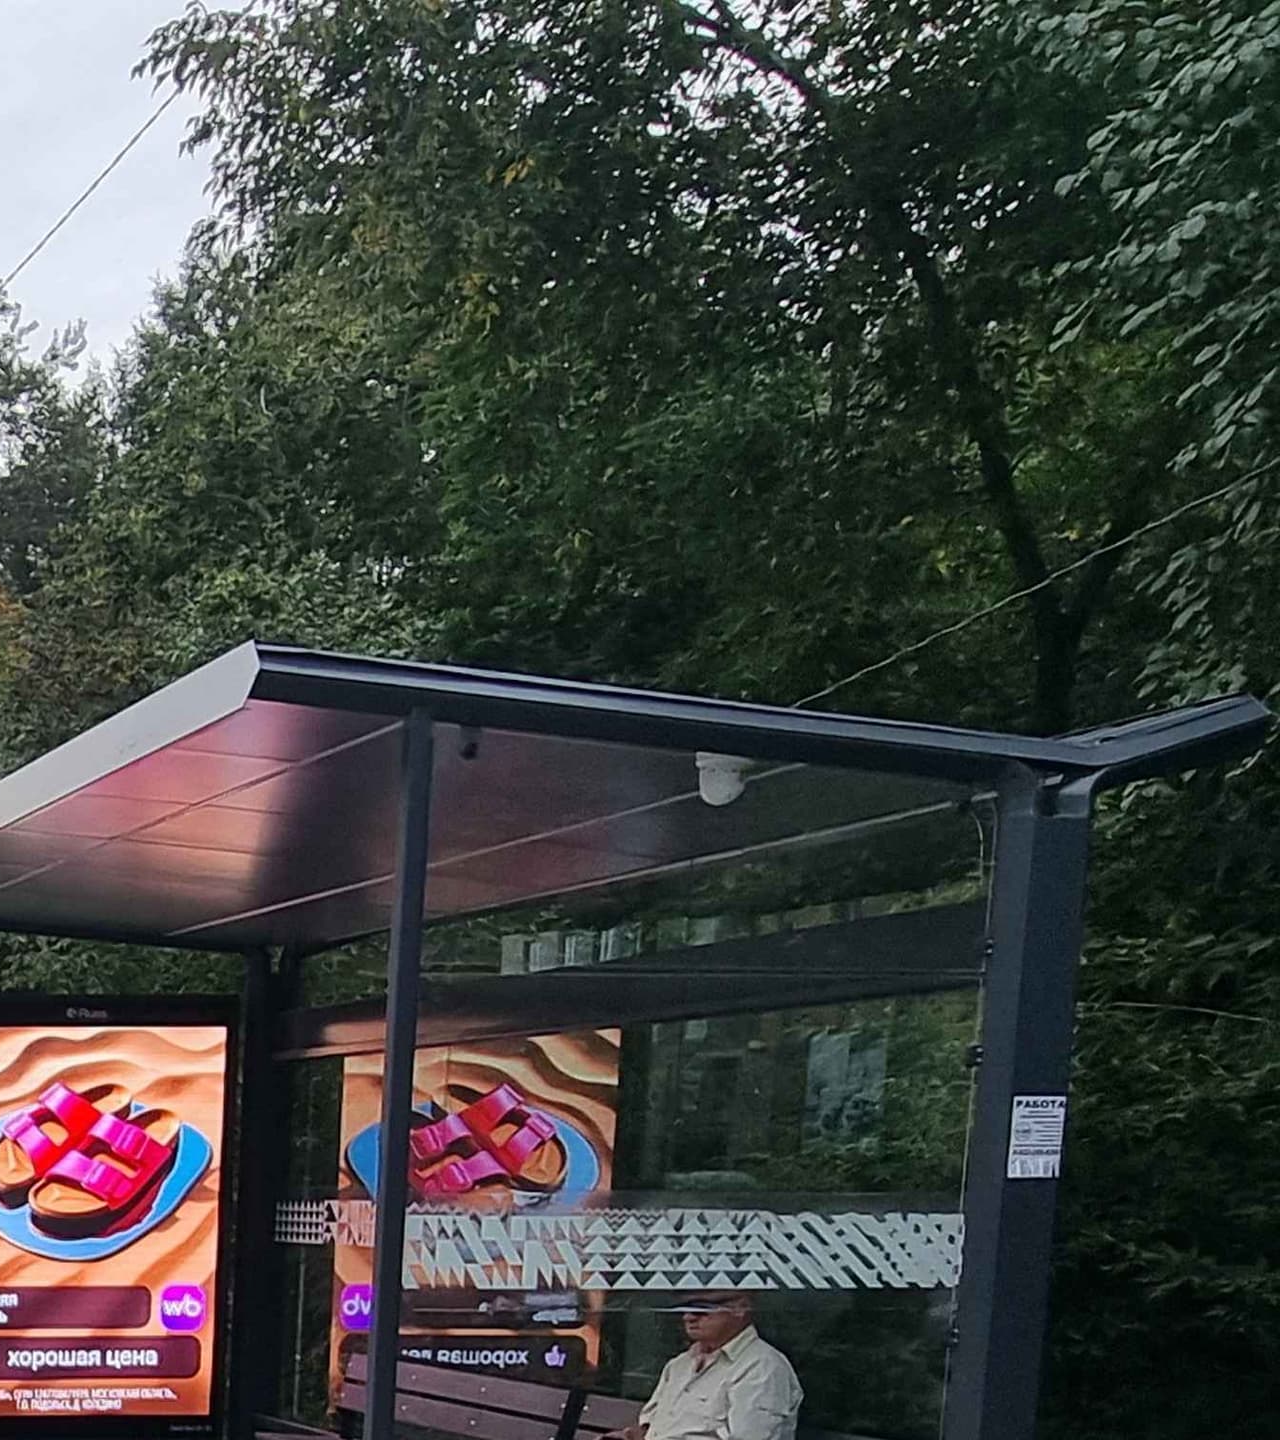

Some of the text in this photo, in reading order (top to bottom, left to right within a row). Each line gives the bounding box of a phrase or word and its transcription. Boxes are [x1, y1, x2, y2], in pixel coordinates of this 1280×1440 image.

[1016, 1100, 1065, 1109] РАБОТА
[163, 1294, 202, 1317] wb
[7, 1349, 159, 1371] хорошая цена
